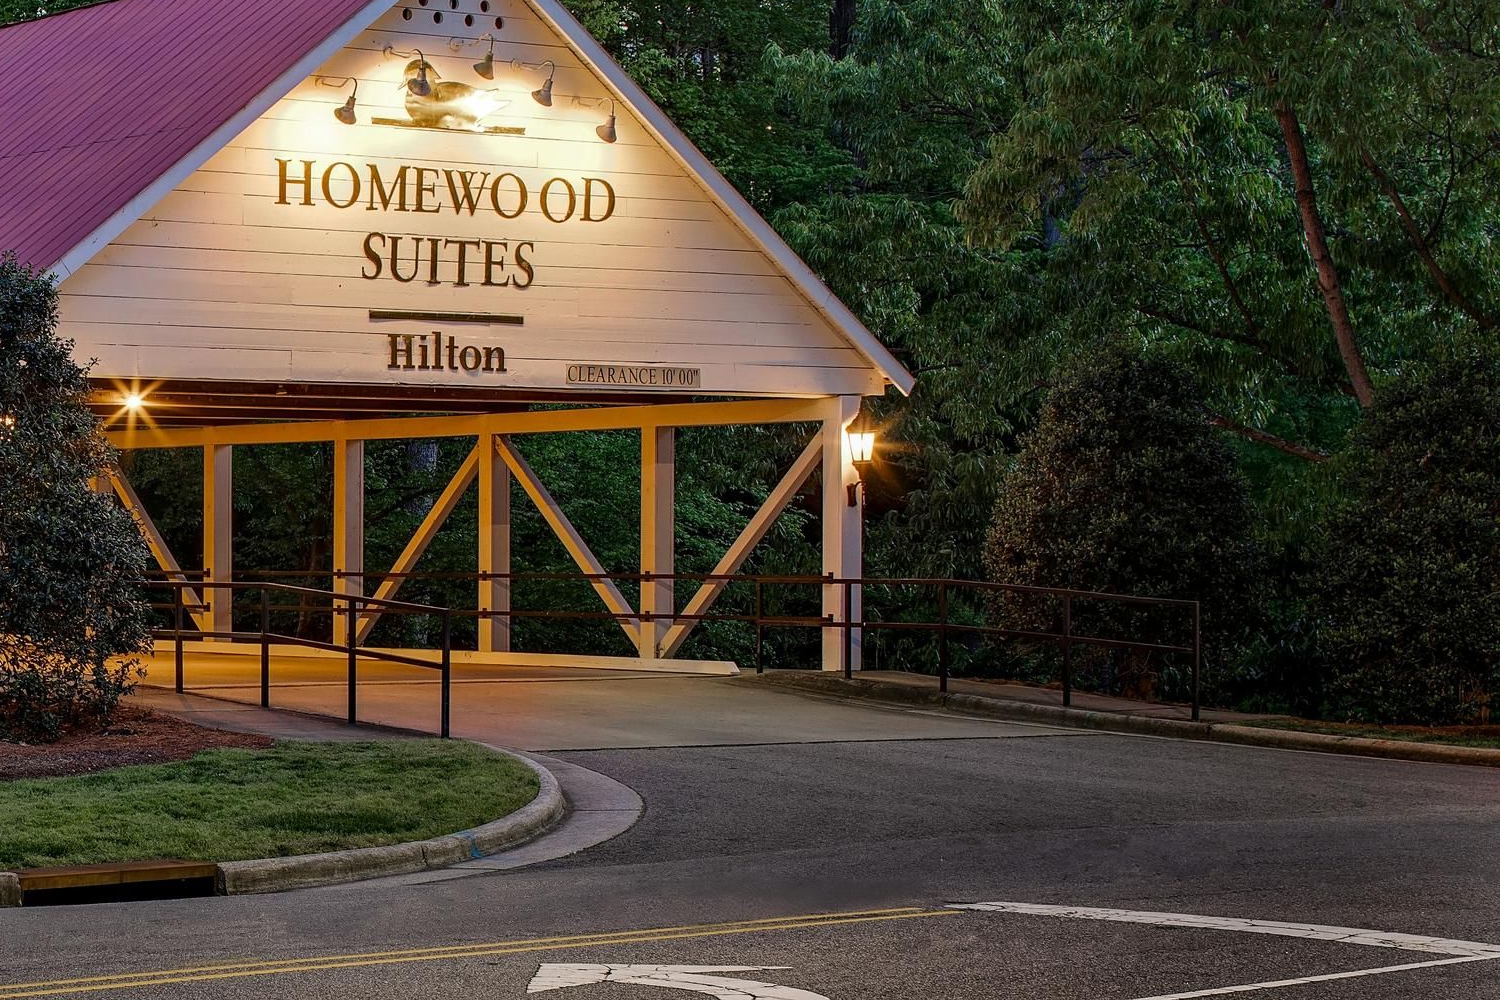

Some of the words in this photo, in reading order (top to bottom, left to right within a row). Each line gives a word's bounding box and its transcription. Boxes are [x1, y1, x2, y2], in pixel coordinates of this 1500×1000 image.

[274, 157, 616, 224] HOMEWOOD
[361, 232, 535, 289] SUITES
[387, 332, 507, 373] Hilton
[567, 365, 657, 385] CLEARANCE
